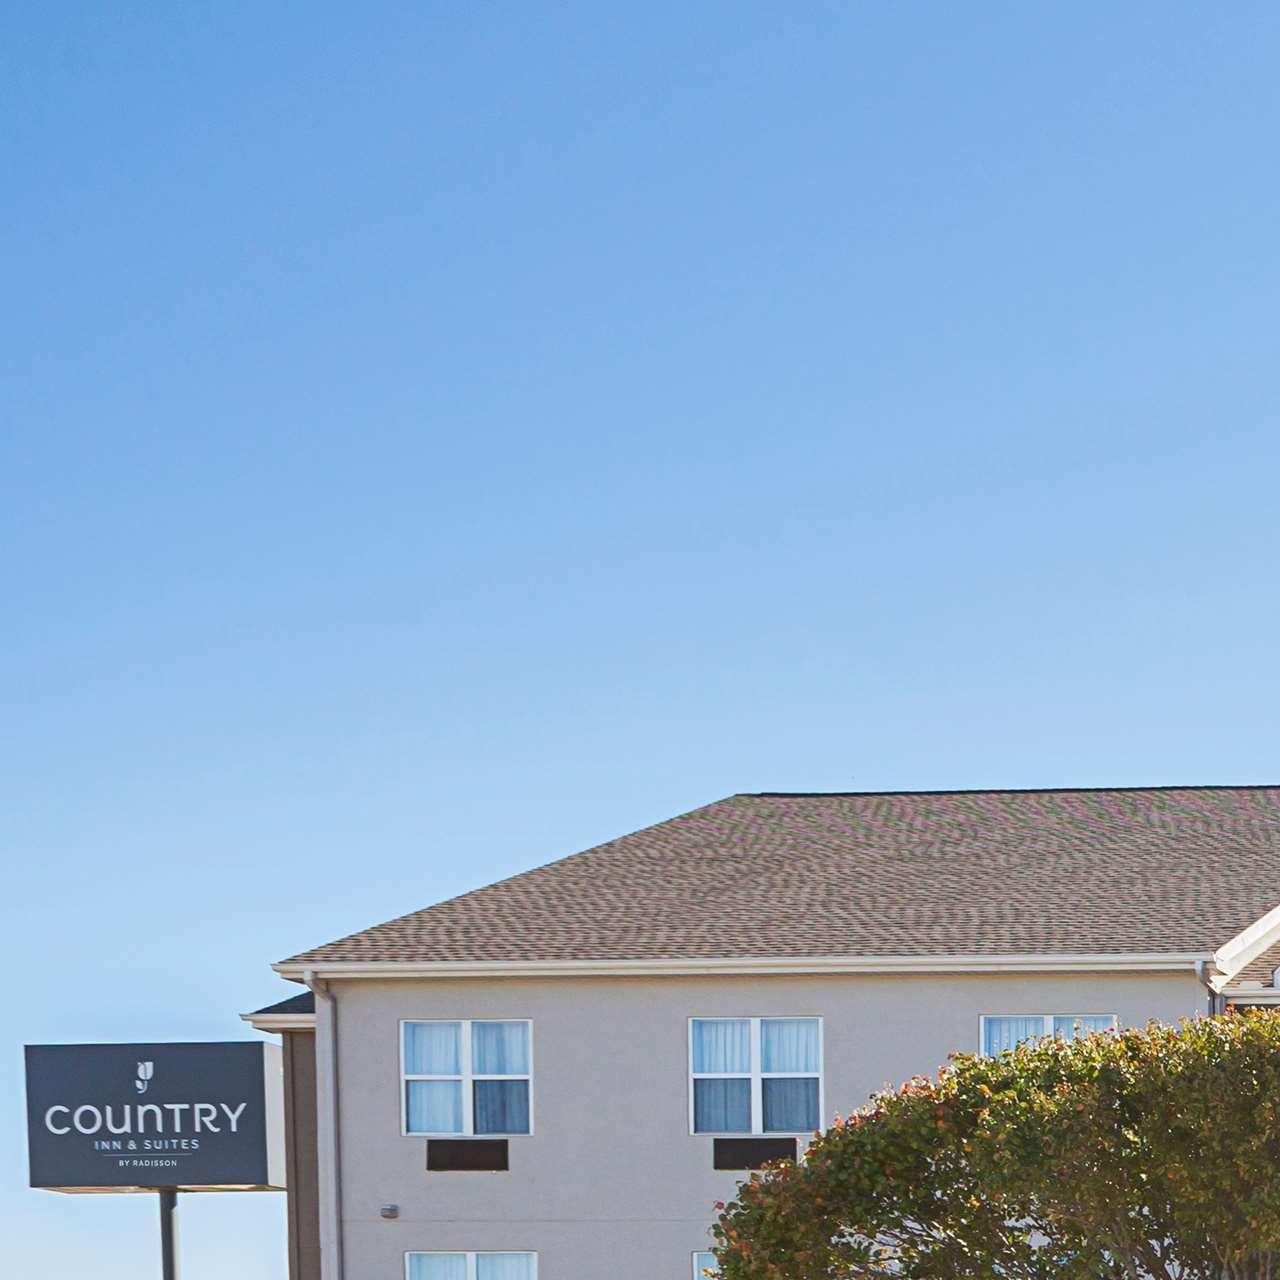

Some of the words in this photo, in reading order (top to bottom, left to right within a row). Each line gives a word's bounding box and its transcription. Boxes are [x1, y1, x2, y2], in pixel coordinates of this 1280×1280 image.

[94, 1140, 121, 1151] INN
[127, 1140, 137, 1150] &
[143, 1139, 200, 1150] SUITES
